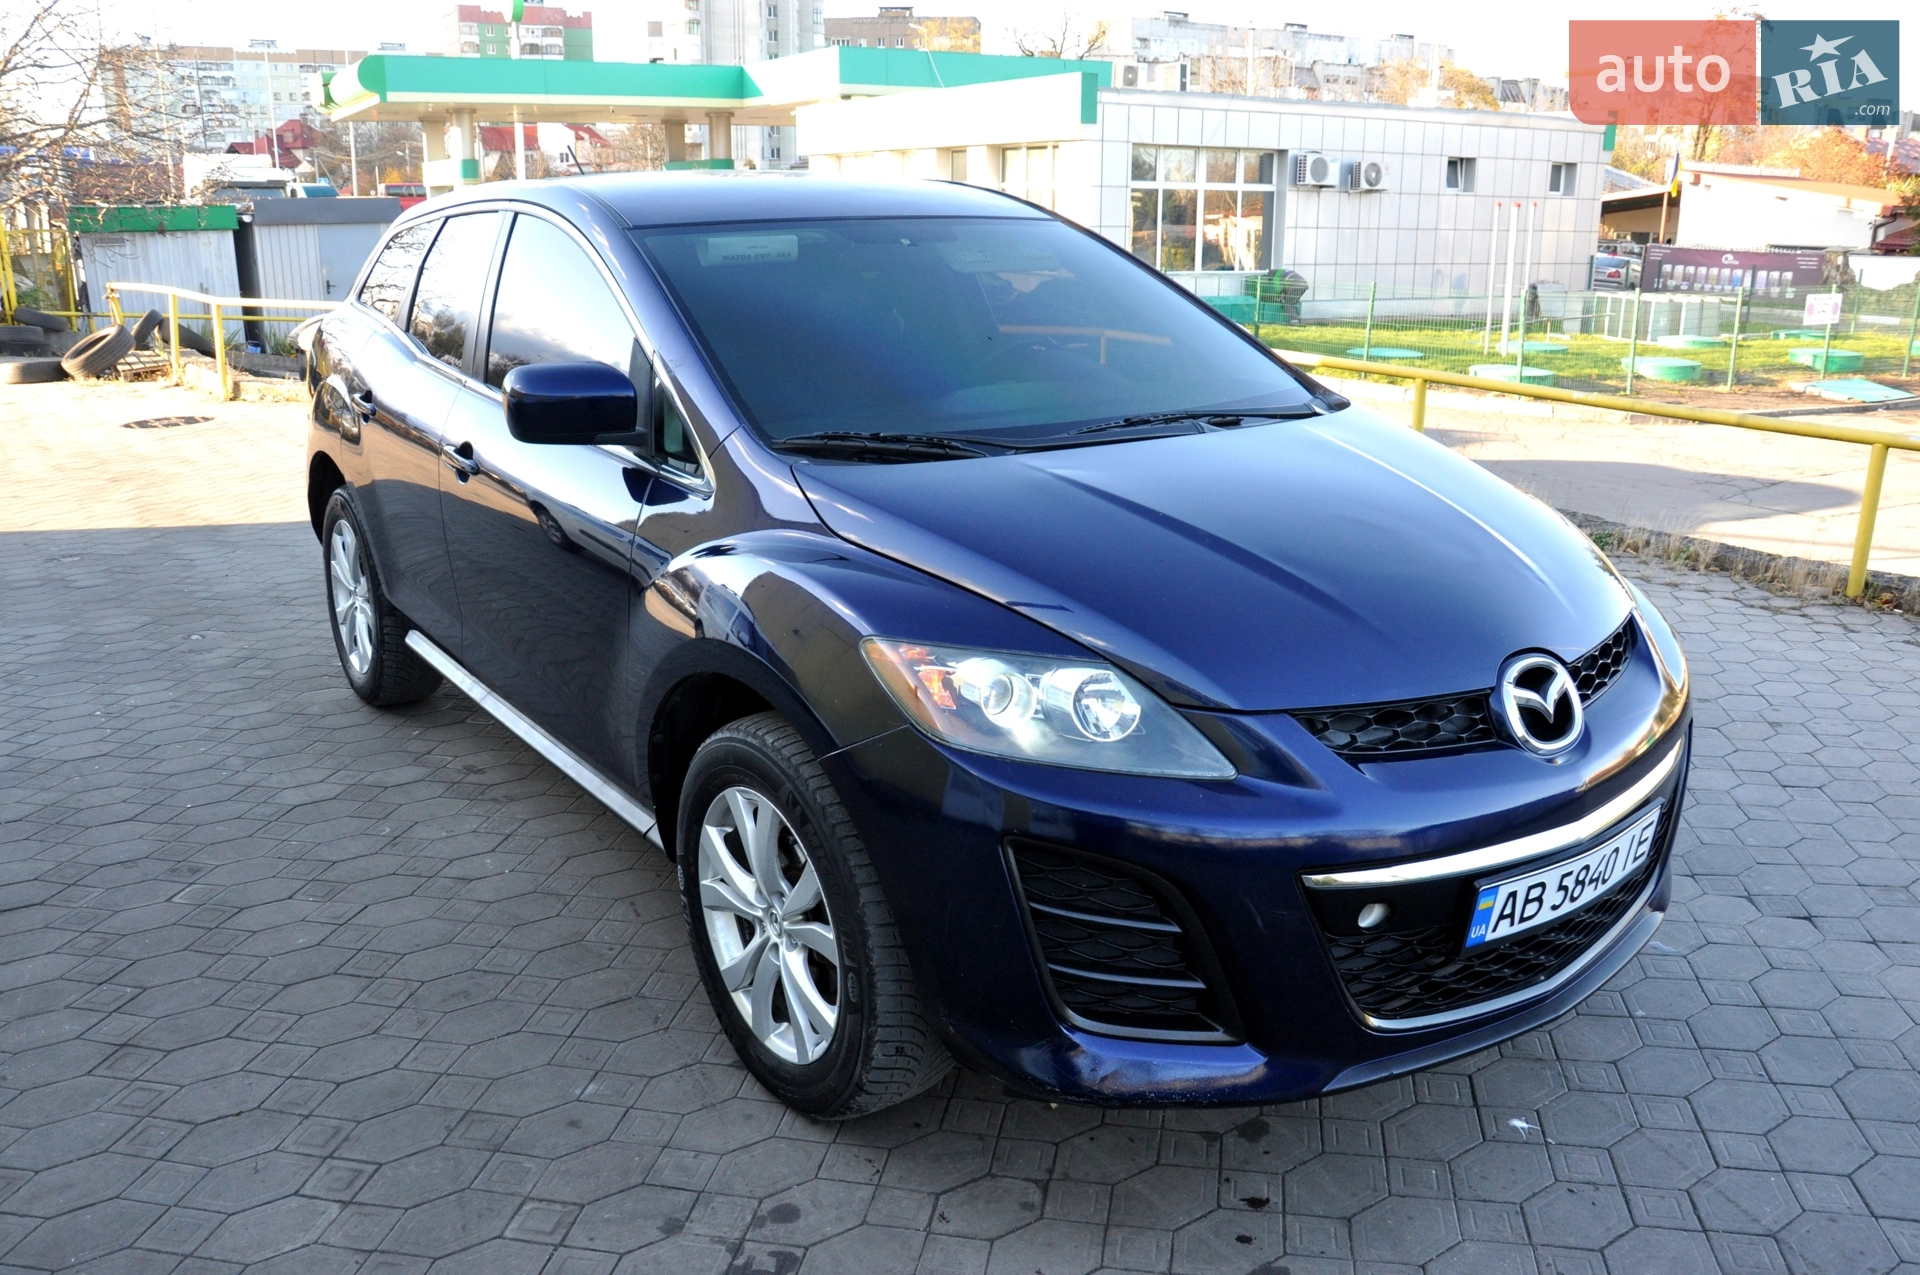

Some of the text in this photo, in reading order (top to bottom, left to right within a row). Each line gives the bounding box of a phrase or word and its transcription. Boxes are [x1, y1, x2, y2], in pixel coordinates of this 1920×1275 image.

[722, 253, 752, 261] MAZDA
[754, 252, 770, 260] CX7
[1491, 819, 1655, 934] AB 5840 IE
[1470, 922, 1486, 939] UA
